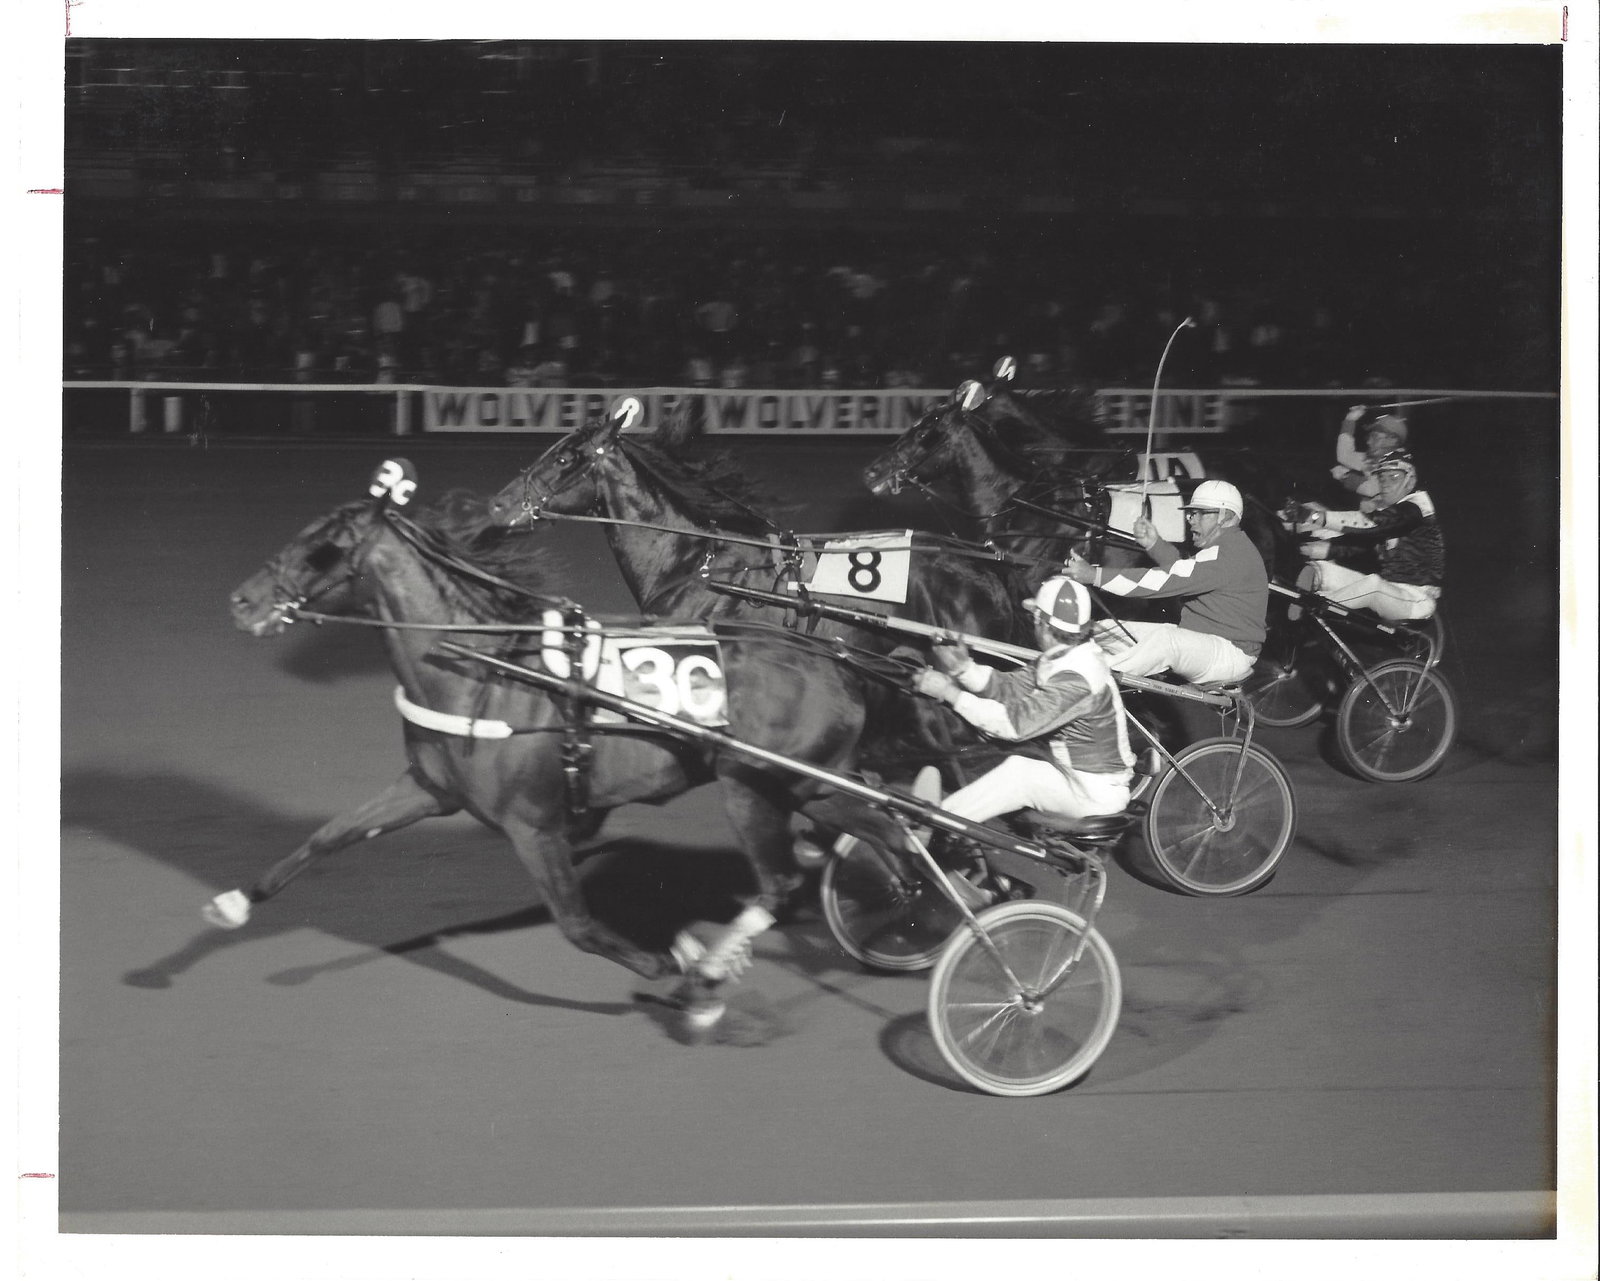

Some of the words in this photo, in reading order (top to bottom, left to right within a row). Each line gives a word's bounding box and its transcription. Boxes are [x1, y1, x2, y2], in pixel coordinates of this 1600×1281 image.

[716, 393, 926, 429] WOLVERIN
[370, 460, 417, 505] 3C
[848, 546, 882, 593] 8
[620, 647, 724, 717] 3C
